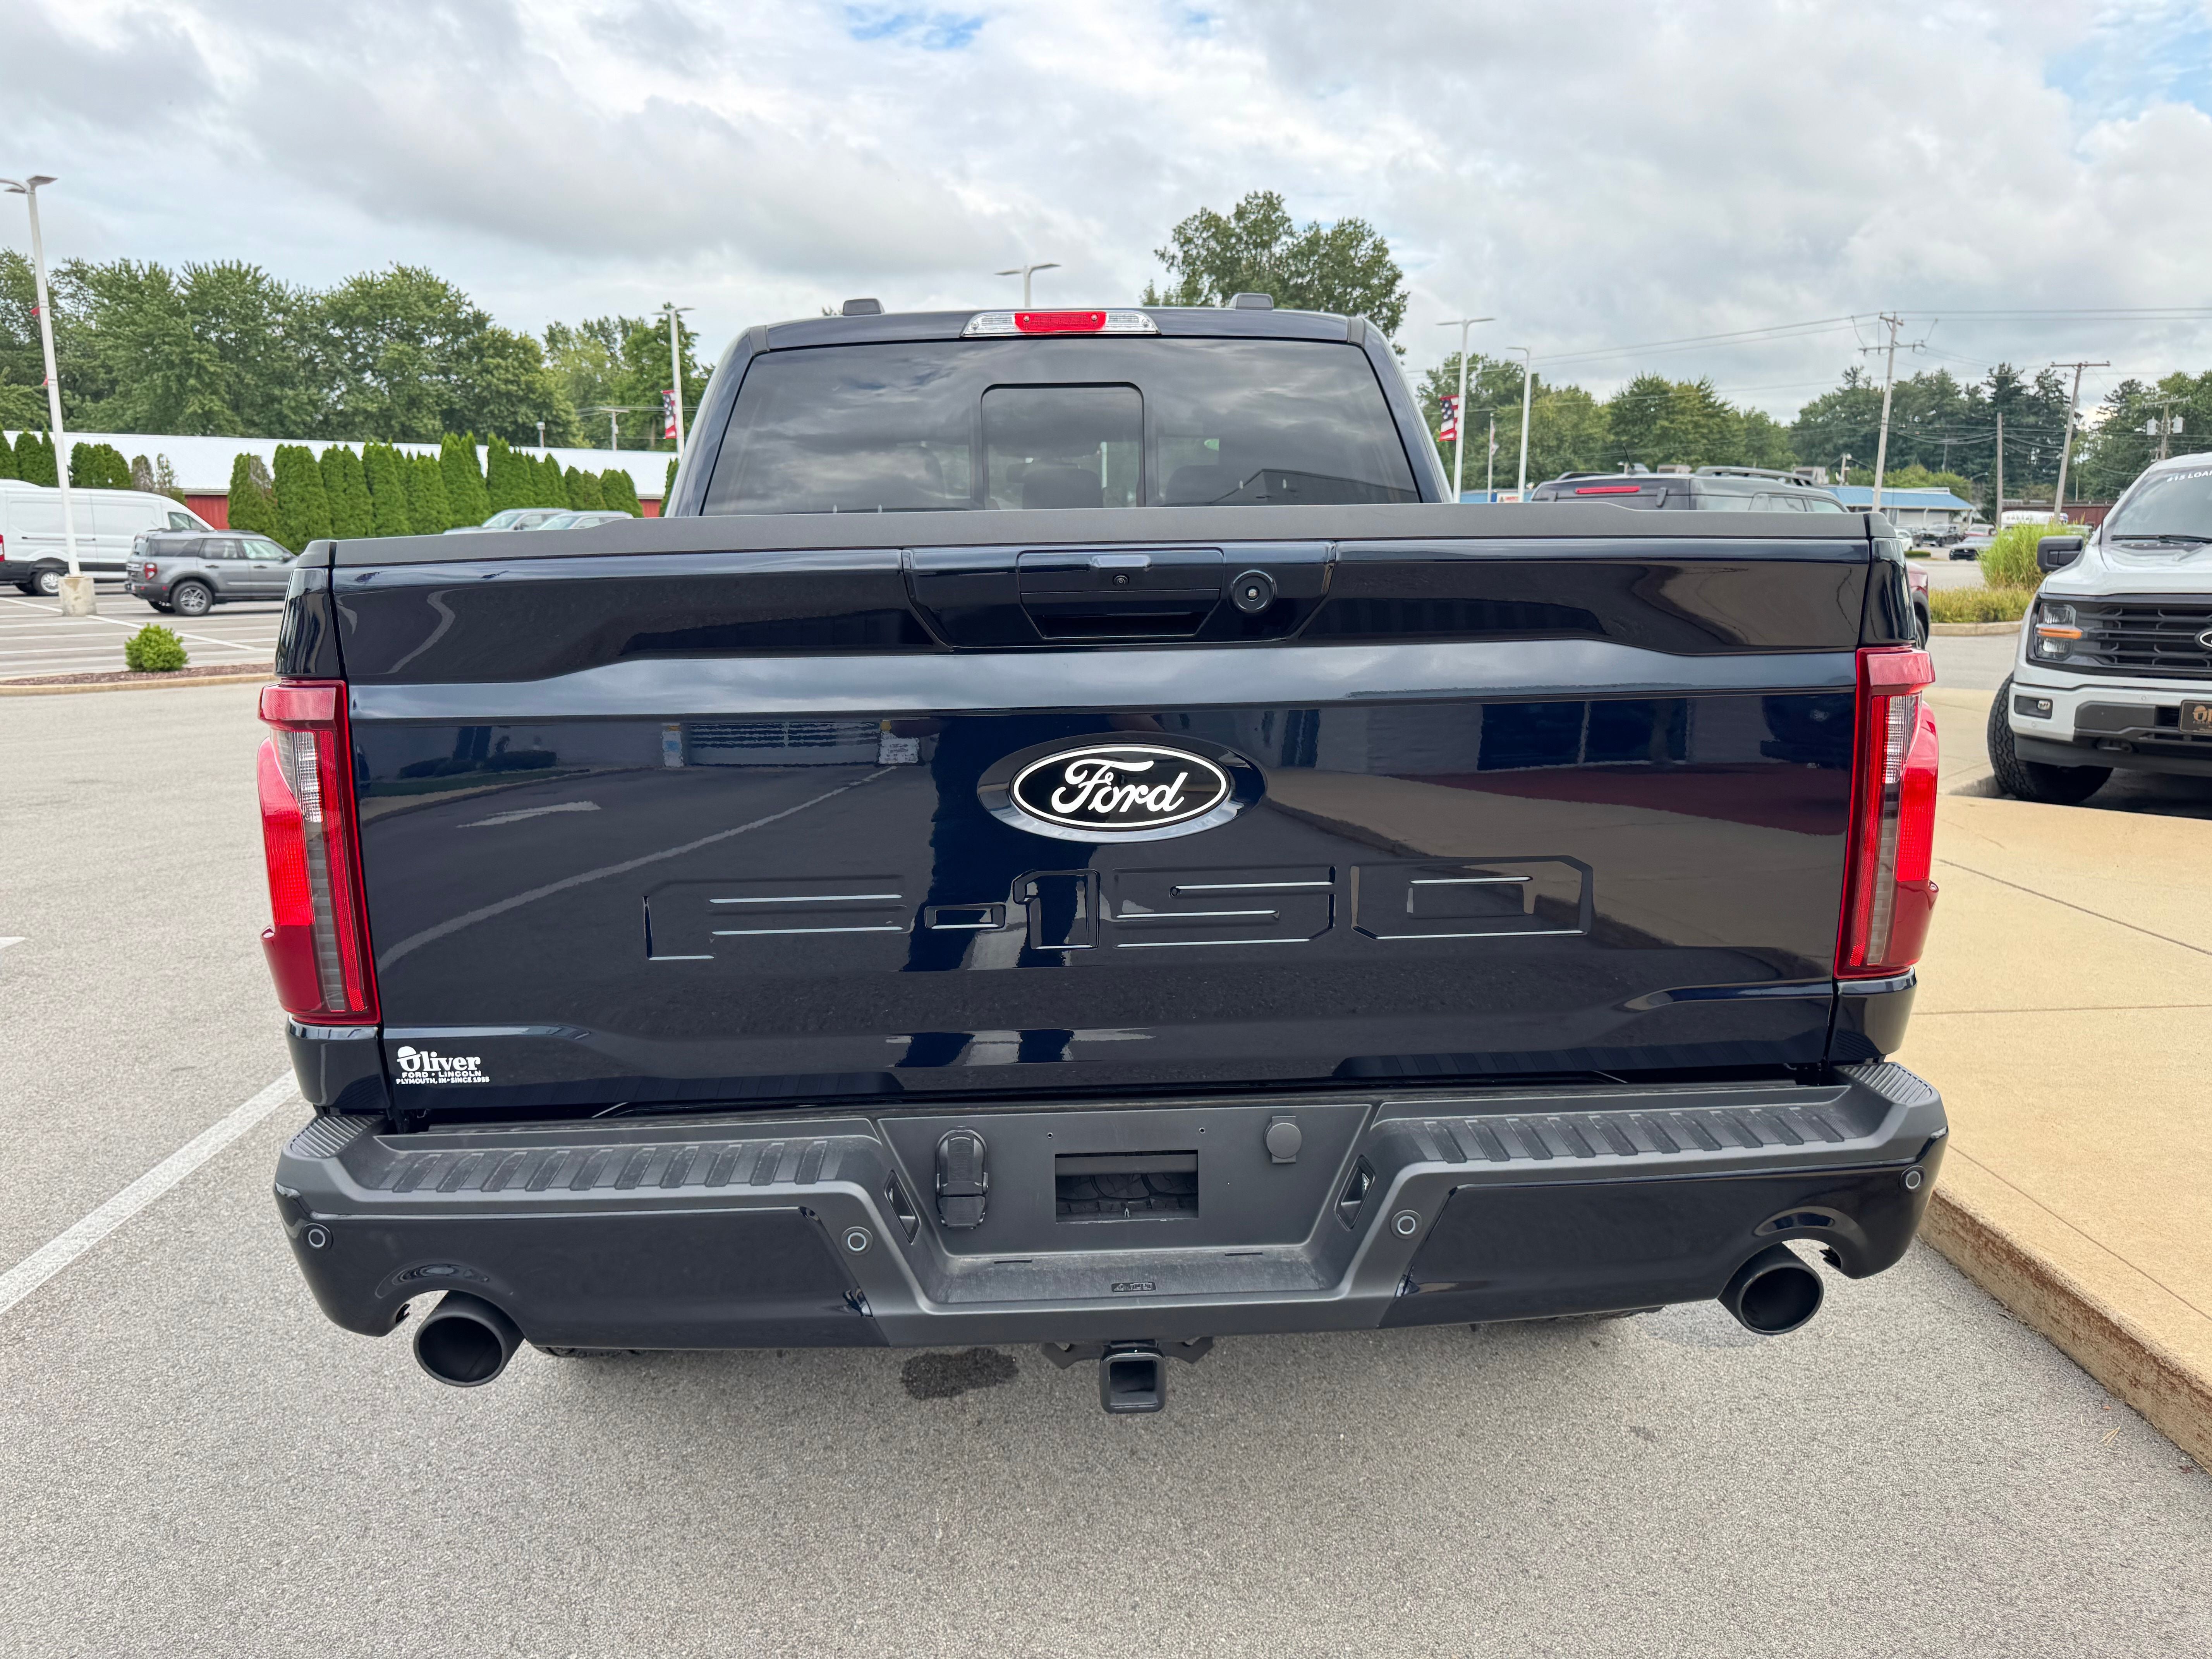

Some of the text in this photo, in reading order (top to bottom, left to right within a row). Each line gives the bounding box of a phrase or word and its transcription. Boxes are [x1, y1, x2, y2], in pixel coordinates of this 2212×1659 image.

[1051, 759, 1188, 813] Ford
[643, 855, 1594, 961] F-150
[397, 1046, 481, 1072] Oliver
